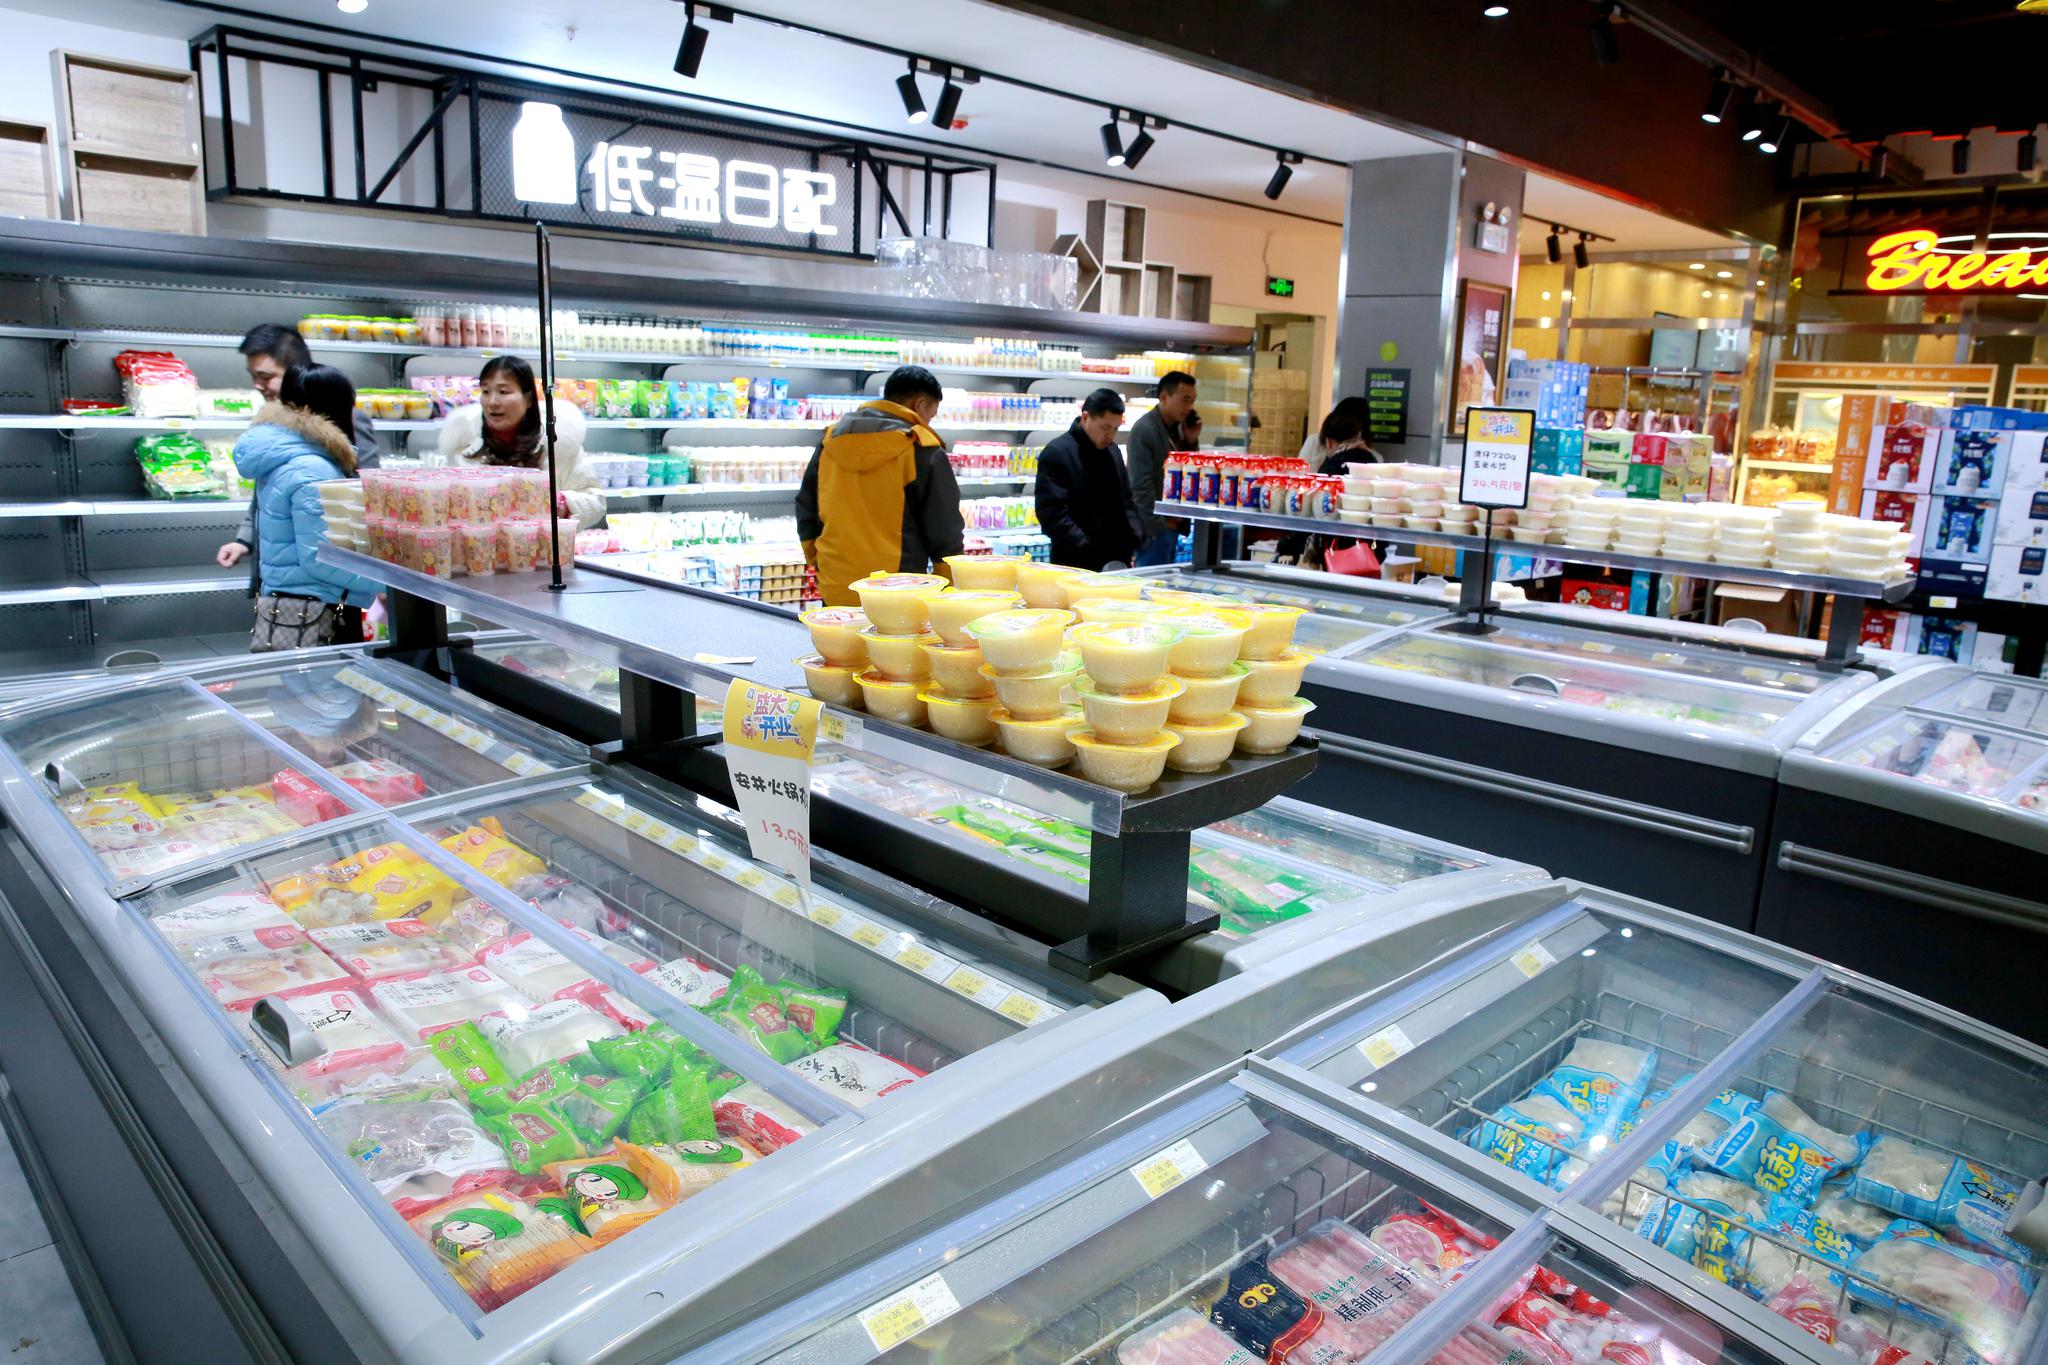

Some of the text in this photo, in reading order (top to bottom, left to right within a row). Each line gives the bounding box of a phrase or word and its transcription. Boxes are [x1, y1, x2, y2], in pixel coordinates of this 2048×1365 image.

[589, 141, 838, 236] 低温日配
[1492, 424, 1516, 435] 开业
[754, 690, 788, 716] 盛大
[759, 715, 800, 741] 开业
